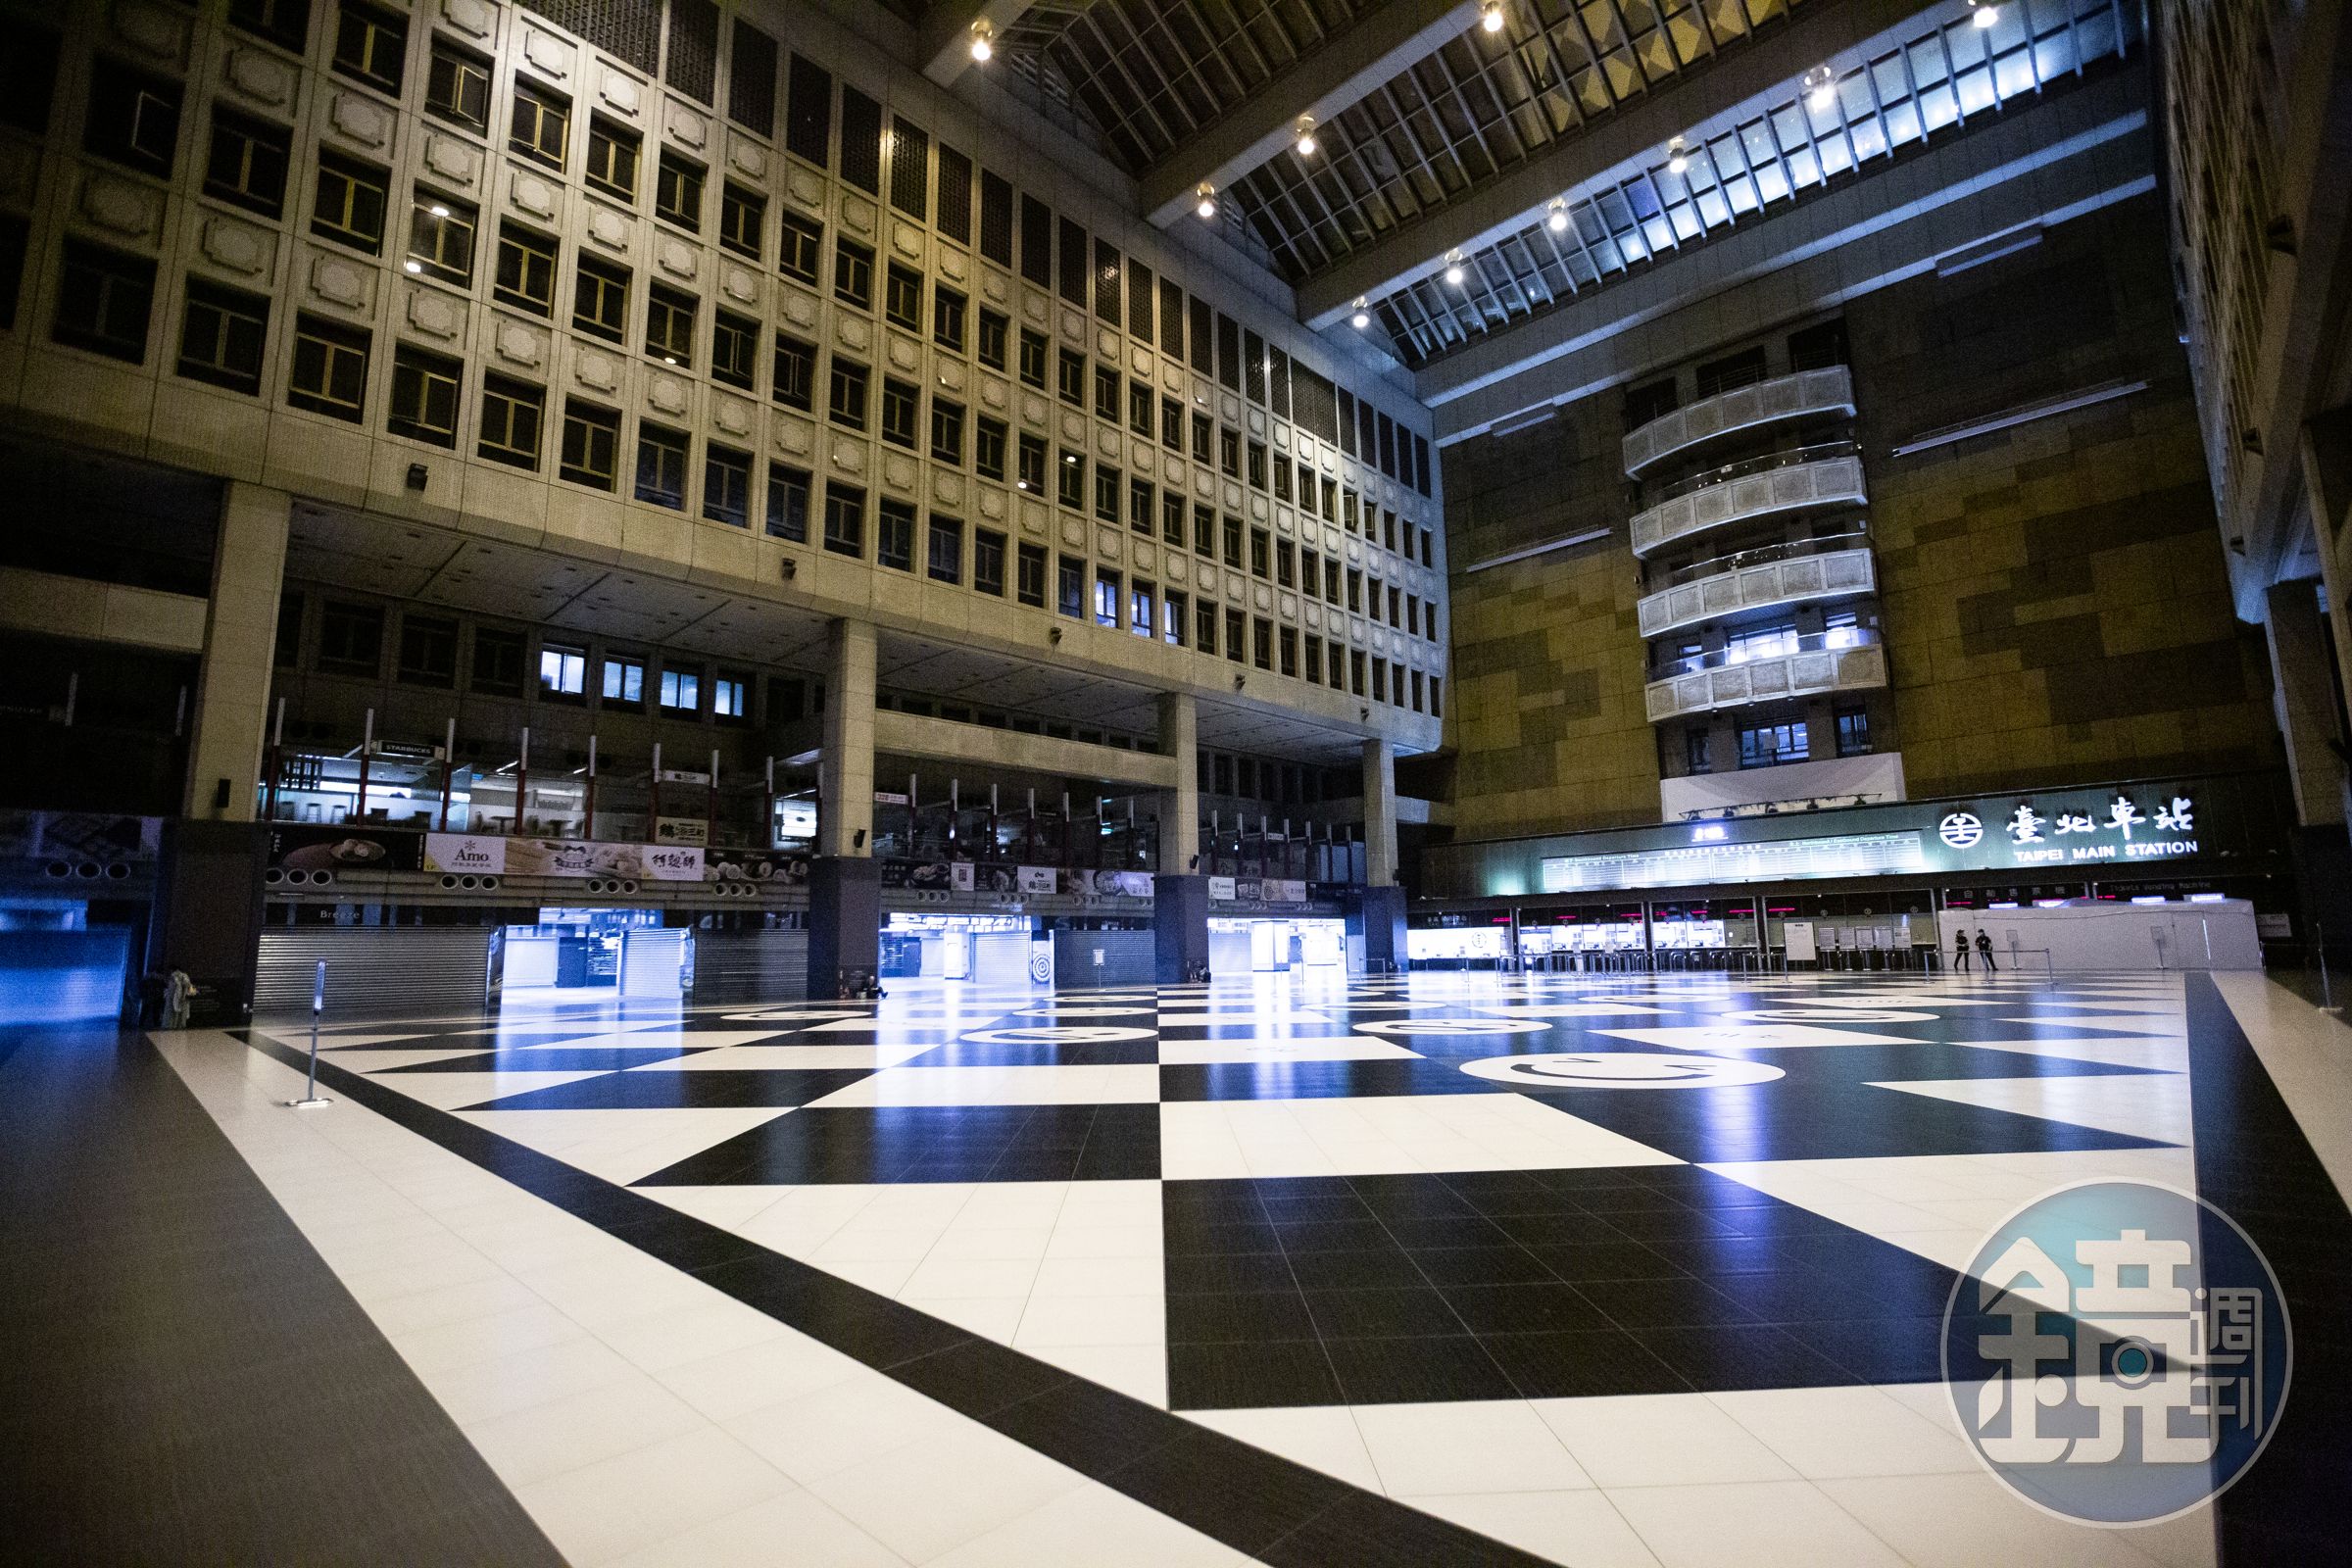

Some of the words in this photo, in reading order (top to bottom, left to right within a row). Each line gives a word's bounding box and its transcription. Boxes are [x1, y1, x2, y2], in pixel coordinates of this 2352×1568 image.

[385, 744, 431, 755] STARBUCKS
[2006, 797, 2193, 845] 臺北車站
[455, 849, 490, 862] Amo
[2014, 850, 2063, 862] TAIPEI
[2073, 846, 2116, 858] MAIN
[2125, 841, 2198, 857] STATION
[319, 909, 361, 919] Breeze
